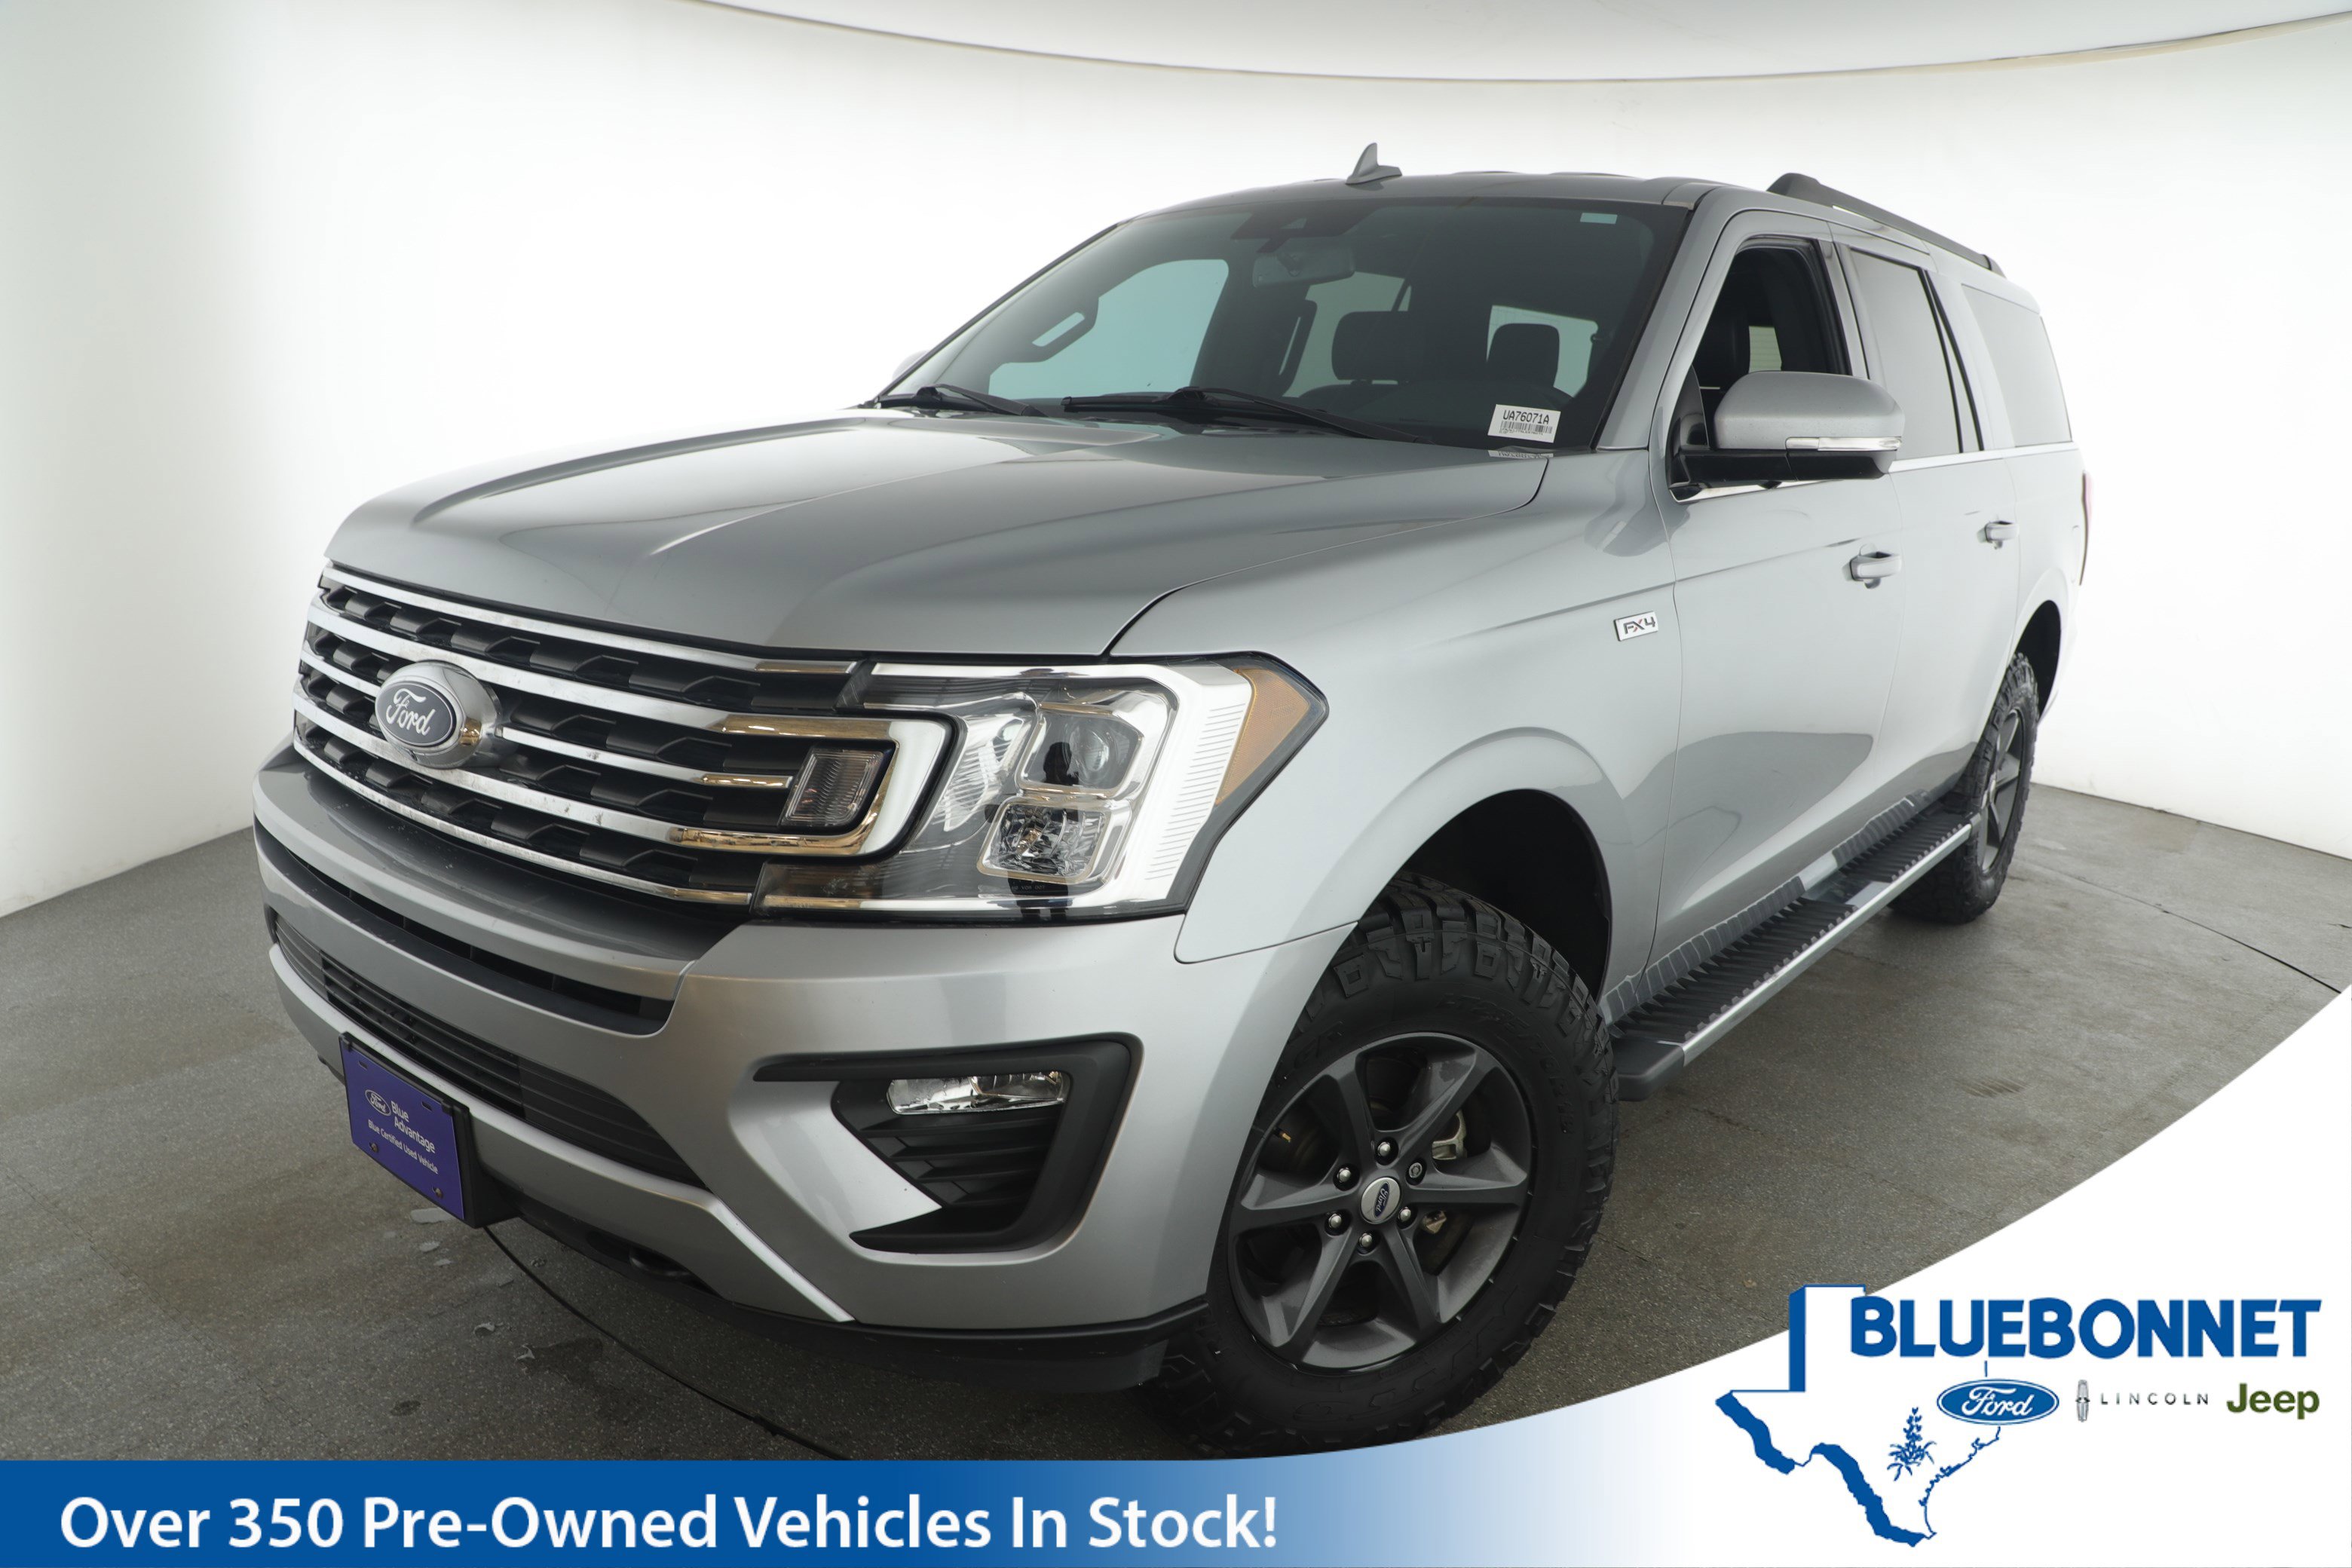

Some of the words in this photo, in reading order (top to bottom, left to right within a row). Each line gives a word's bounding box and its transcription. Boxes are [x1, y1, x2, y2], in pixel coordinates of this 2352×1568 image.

[1502, 409, 1550, 425] UA76071A
[1623, 616, 1656, 635] FX4
[385, 688, 436, 737] Ford
[369, 1092, 387, 1113] Ford
[390, 1100, 410, 1123] Blue
[368, 1119, 381, 1135] Blue
[380, 1128, 403, 1150] Certified
[403, 1143, 418, 1161] Used
[418, 1153, 439, 1174] Vehicle
[394, 1116, 436, 1154] Advantage
[1375, 1188, 1389, 1212] Ford
